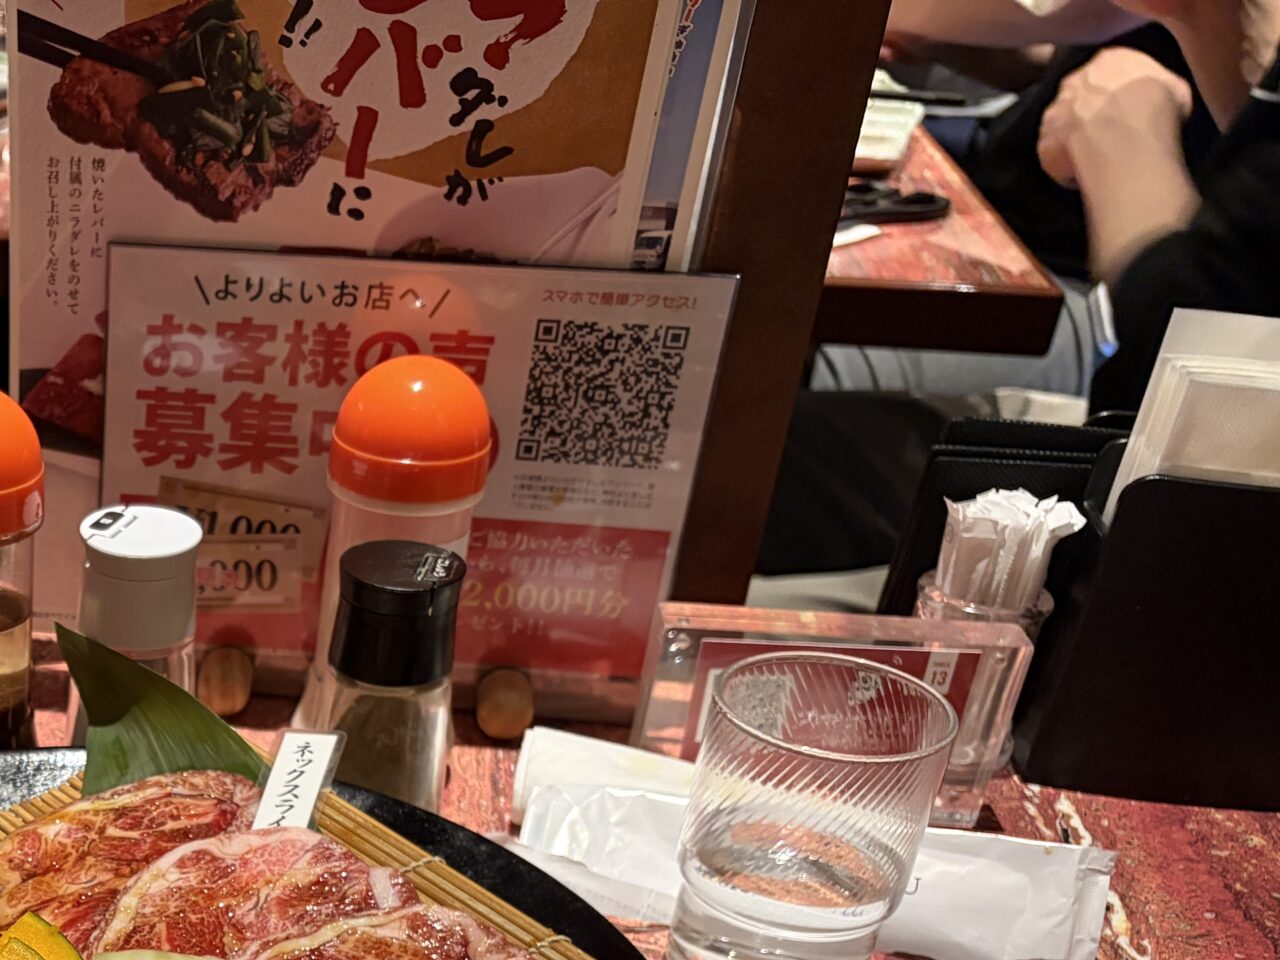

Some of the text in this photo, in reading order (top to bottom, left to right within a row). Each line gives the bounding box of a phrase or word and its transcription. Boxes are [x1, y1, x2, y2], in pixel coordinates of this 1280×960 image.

[320, 0, 463, 221] バーに
[46, 156, 60, 306] お召し上がりください。
[67, 156, 82, 314] 付属のニラダレをのせて
[91, 157, 105, 258] 焼いたレバーに
[470, 615, 545, 635] ゼント!!
[931, 669, 948, 687] 13
